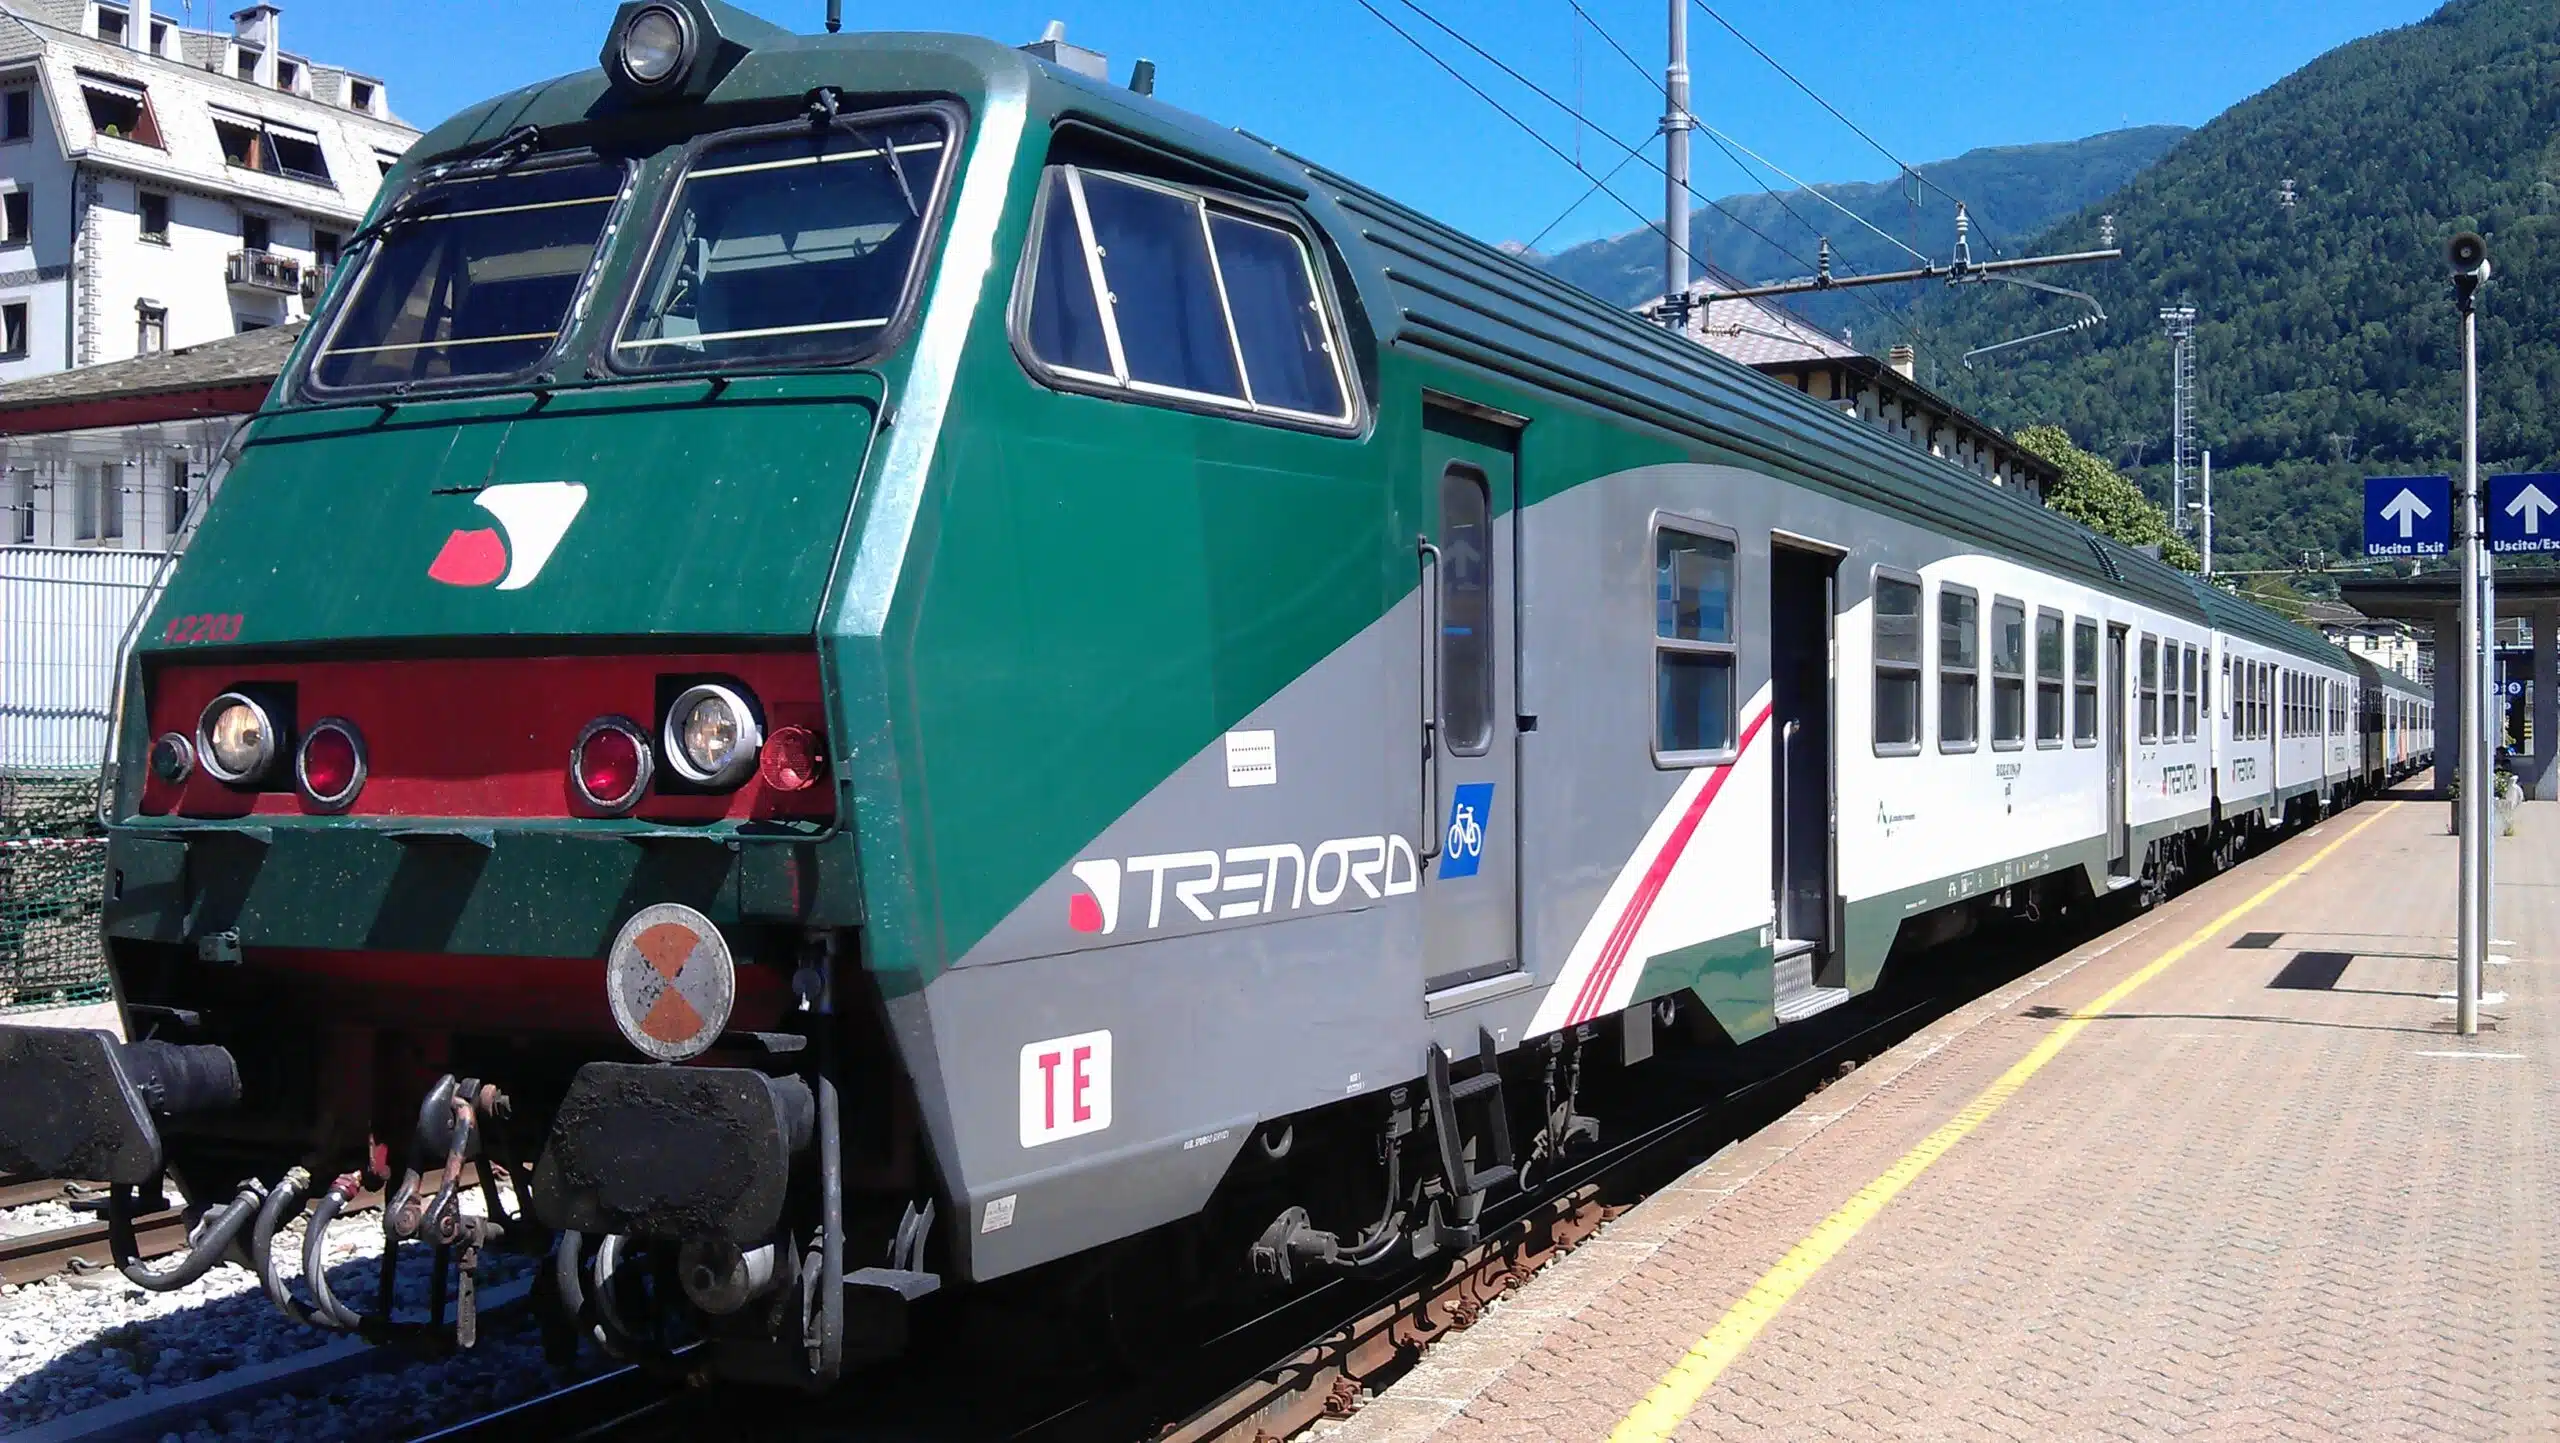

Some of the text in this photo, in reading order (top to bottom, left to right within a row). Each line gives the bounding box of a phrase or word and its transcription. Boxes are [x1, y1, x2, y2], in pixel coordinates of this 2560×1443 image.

[2369, 541, 2445, 555] Uscita Exit
[163, 612, 244, 645] 12203
[1126, 833, 1418, 928] TRENORD
[1038, 1045, 1091, 1130] TE
